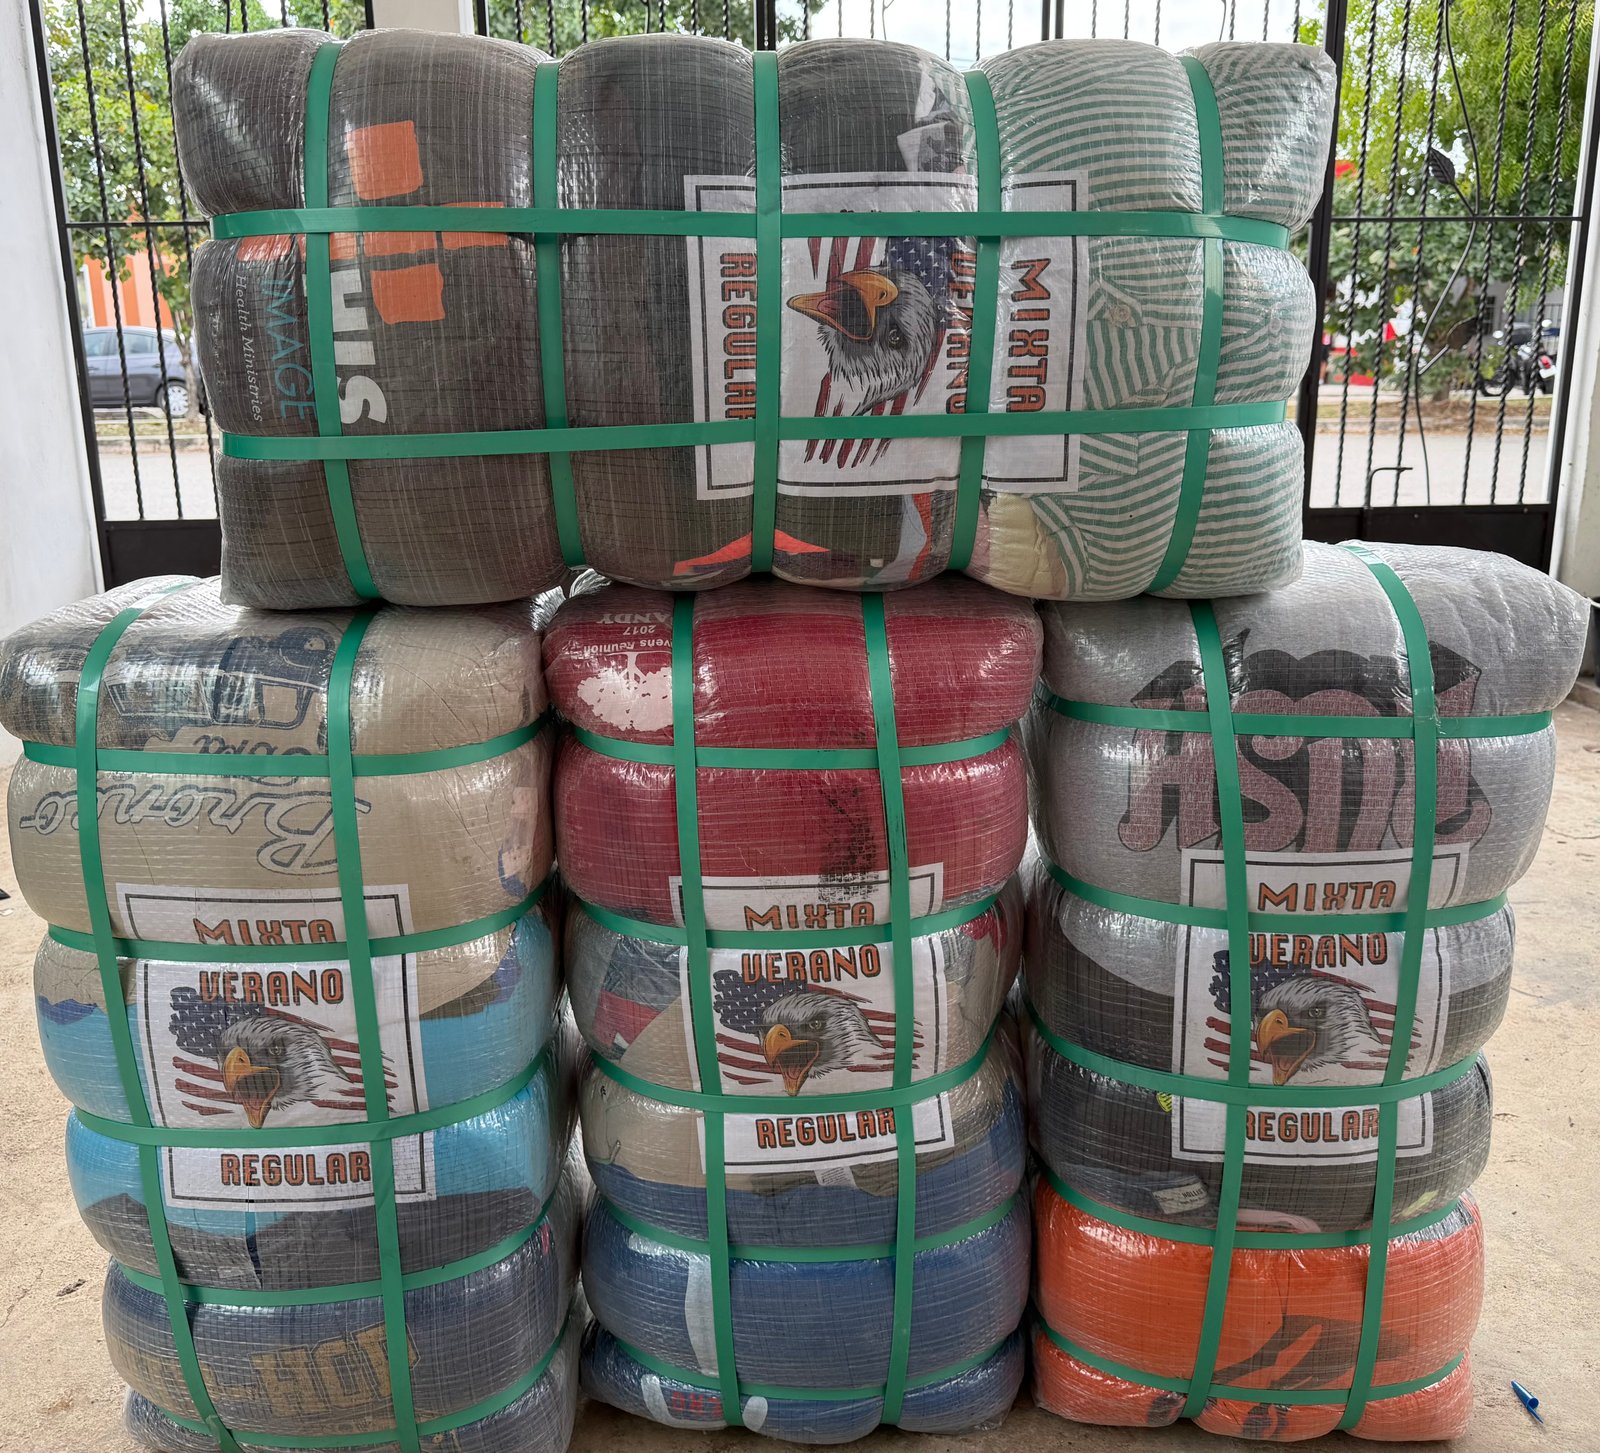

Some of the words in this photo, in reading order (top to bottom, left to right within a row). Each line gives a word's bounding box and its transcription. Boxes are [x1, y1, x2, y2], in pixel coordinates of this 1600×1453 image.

[235, 275, 252, 332] Health
[260, 277, 318, 421] IMAGE
[302, 268, 388, 424] HIS
[1006, 257, 1051, 413] MIXTA
[242, 337, 263, 422] Ministries
[597, 612, 671, 624] ANDY
[622, 625, 656, 636] 2017
[583, 641, 635, 653] Reunion
[640, 638, 672, 648] vens
[1257, 880, 1396, 911] MIXTA
[193, 918, 337, 945] MIXTA
[744, 901, 875, 930] MIXTA
[742, 944, 881, 983] VERANO
[1249, 932, 1387, 968] VERANO
[199, 968, 344, 1006] VERANO
[756, 1108, 896, 1149] REGULAR
[220, 1151, 372, 1187] REGULAR
